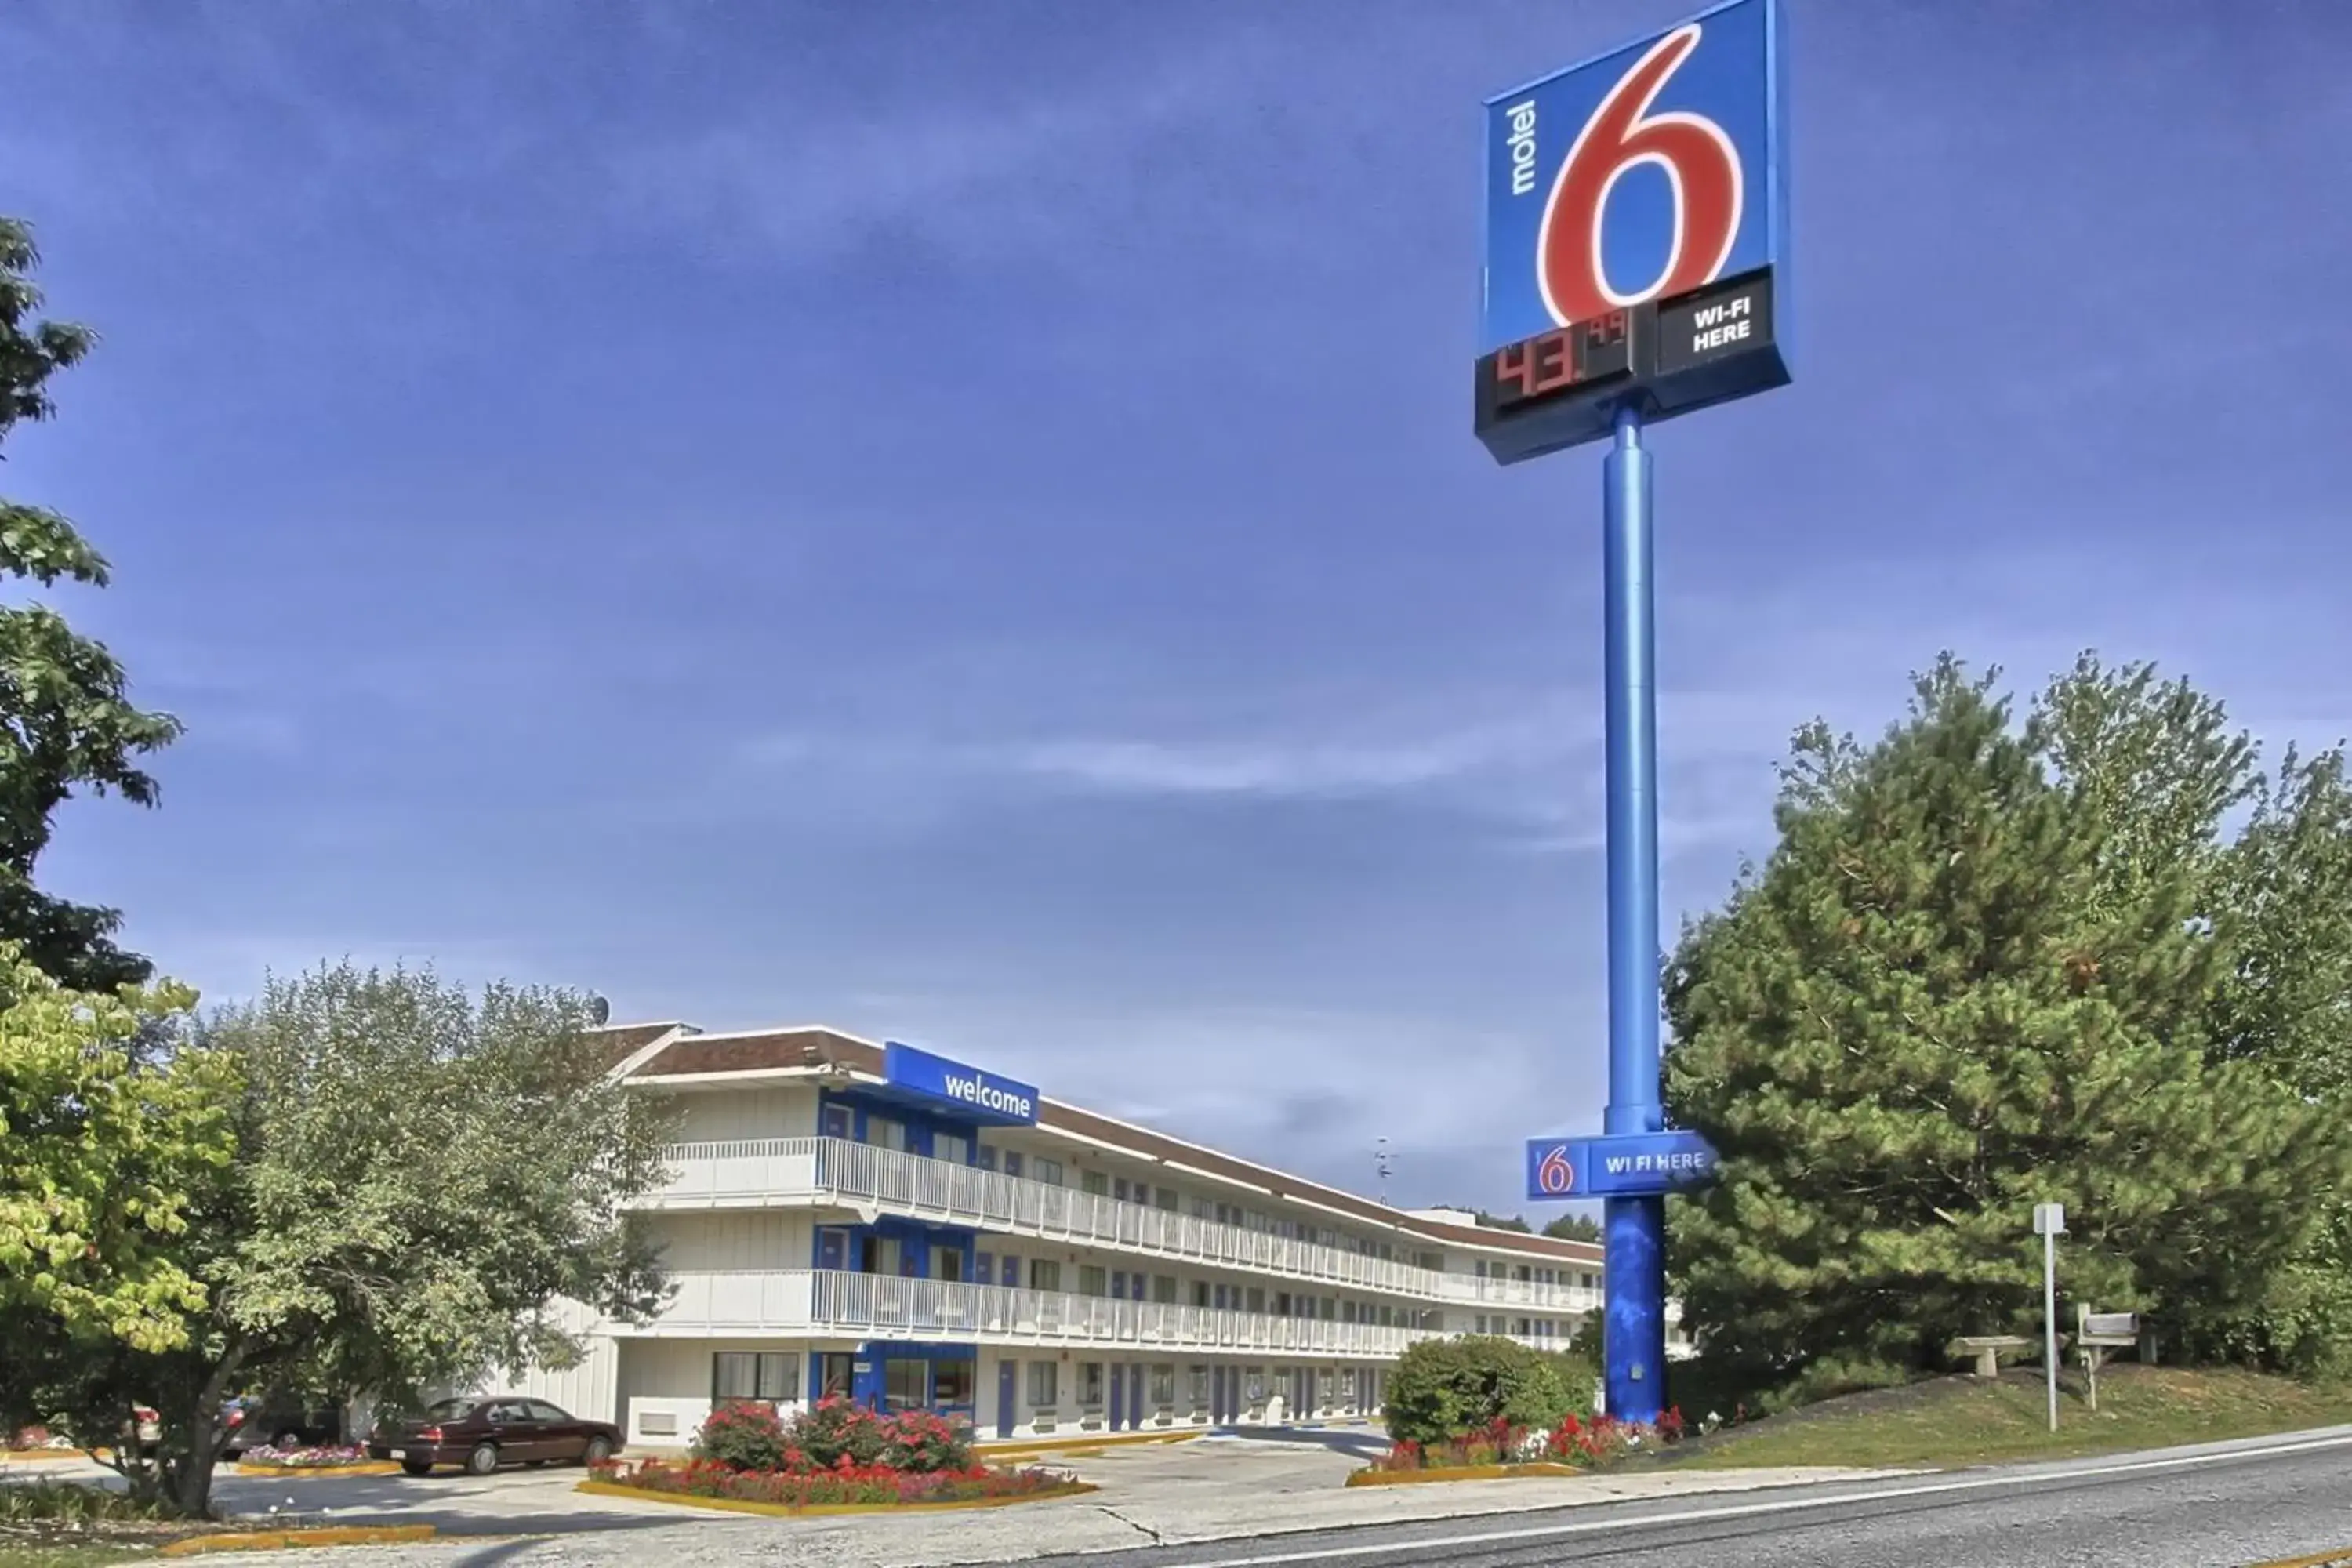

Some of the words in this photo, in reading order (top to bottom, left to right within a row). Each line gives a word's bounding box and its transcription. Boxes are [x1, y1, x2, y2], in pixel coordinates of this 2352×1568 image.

[1506, 100, 1536, 195] motel
[1537, 22, 1744, 328] 6
[1694, 296, 1751, 329] WI-FI
[1693, 319, 1751, 353] HERE
[945, 1074, 1031, 1118] welcome
[1540, 1145, 1573, 1192] 6
[1606, 1157, 1632, 1174] WI
[1636, 1156, 1651, 1171] FI
[1656, 1152, 1705, 1170] HERE
